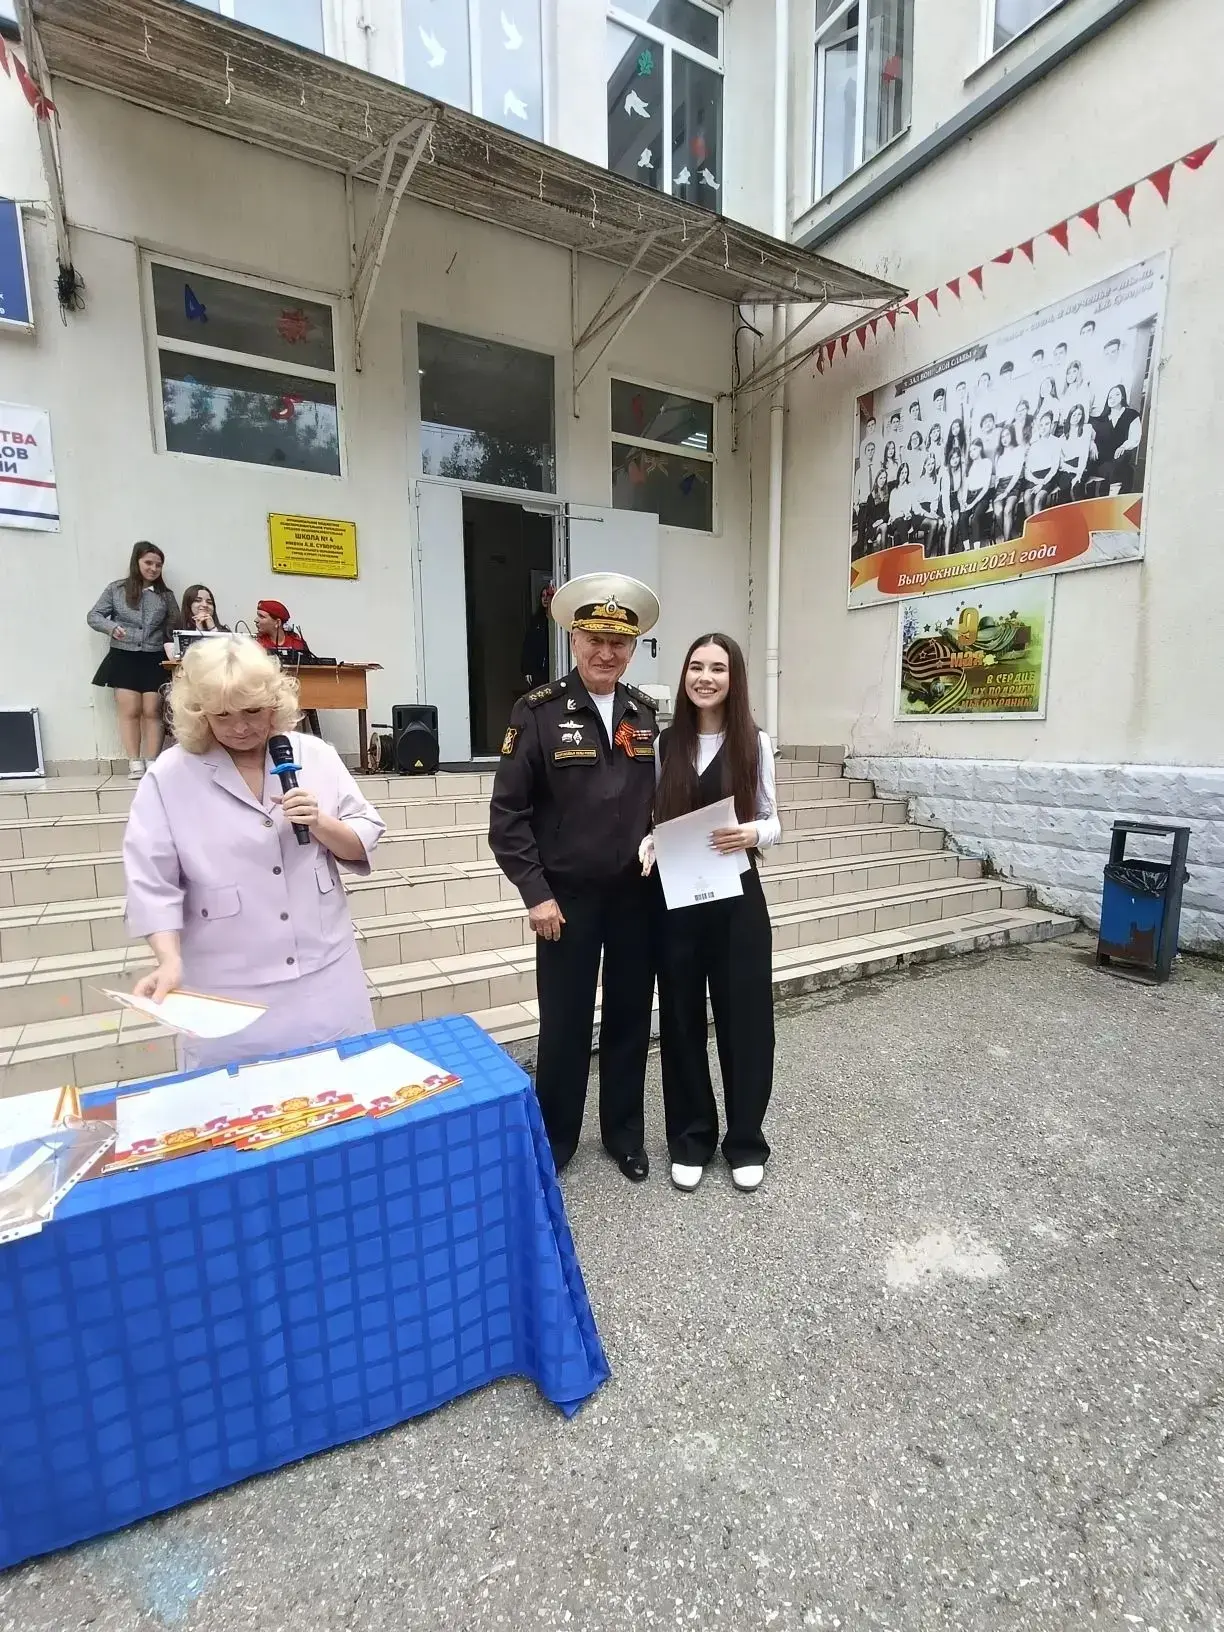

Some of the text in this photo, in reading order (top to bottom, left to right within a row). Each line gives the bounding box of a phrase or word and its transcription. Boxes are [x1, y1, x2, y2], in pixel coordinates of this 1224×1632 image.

[0, 446, 29, 460] ОВ
[294, 533, 320, 542] ШКОЛА
[897, 544, 1058, 587] Выпускники 2021 года
[958, 607, 980, 646] 9
[986, 674, 998, 684] В
